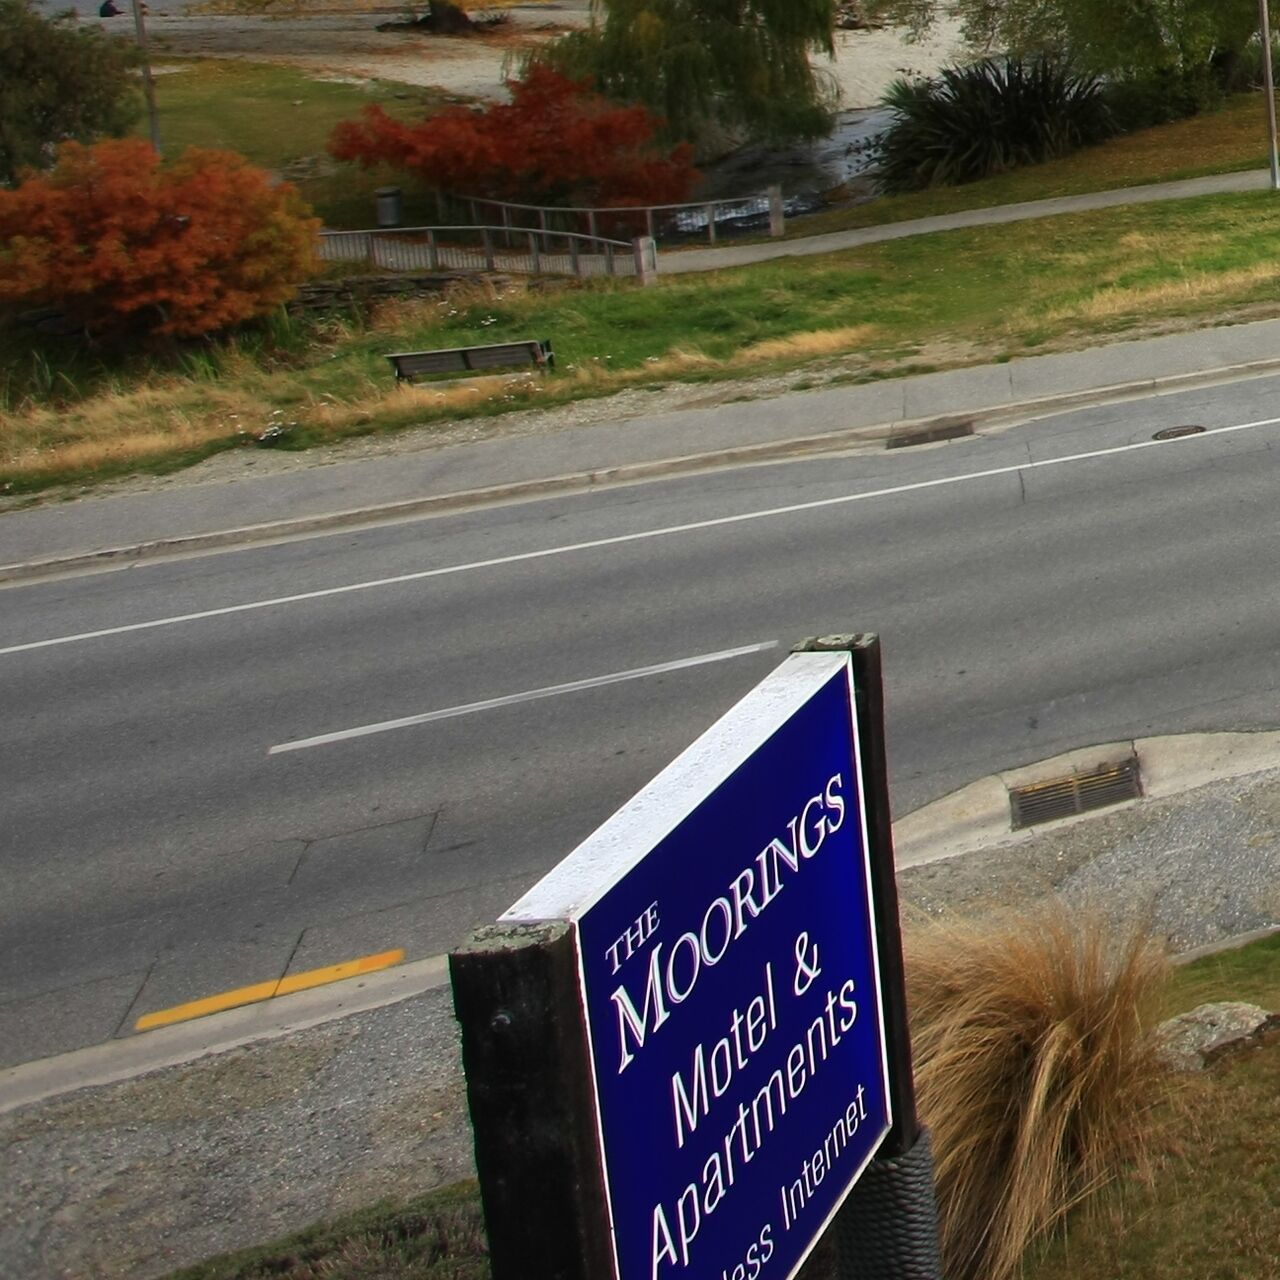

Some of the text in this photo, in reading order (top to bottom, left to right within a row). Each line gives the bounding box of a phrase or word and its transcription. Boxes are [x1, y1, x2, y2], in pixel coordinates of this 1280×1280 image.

[605, 900, 661, 975] THE
[610, 772, 846, 1074] MOORINGS
[651, 979, 858, 1280] Apartments
[672, 931, 822, 1149] Motel &
[722, 1083, 868, 1280] ss Internet
